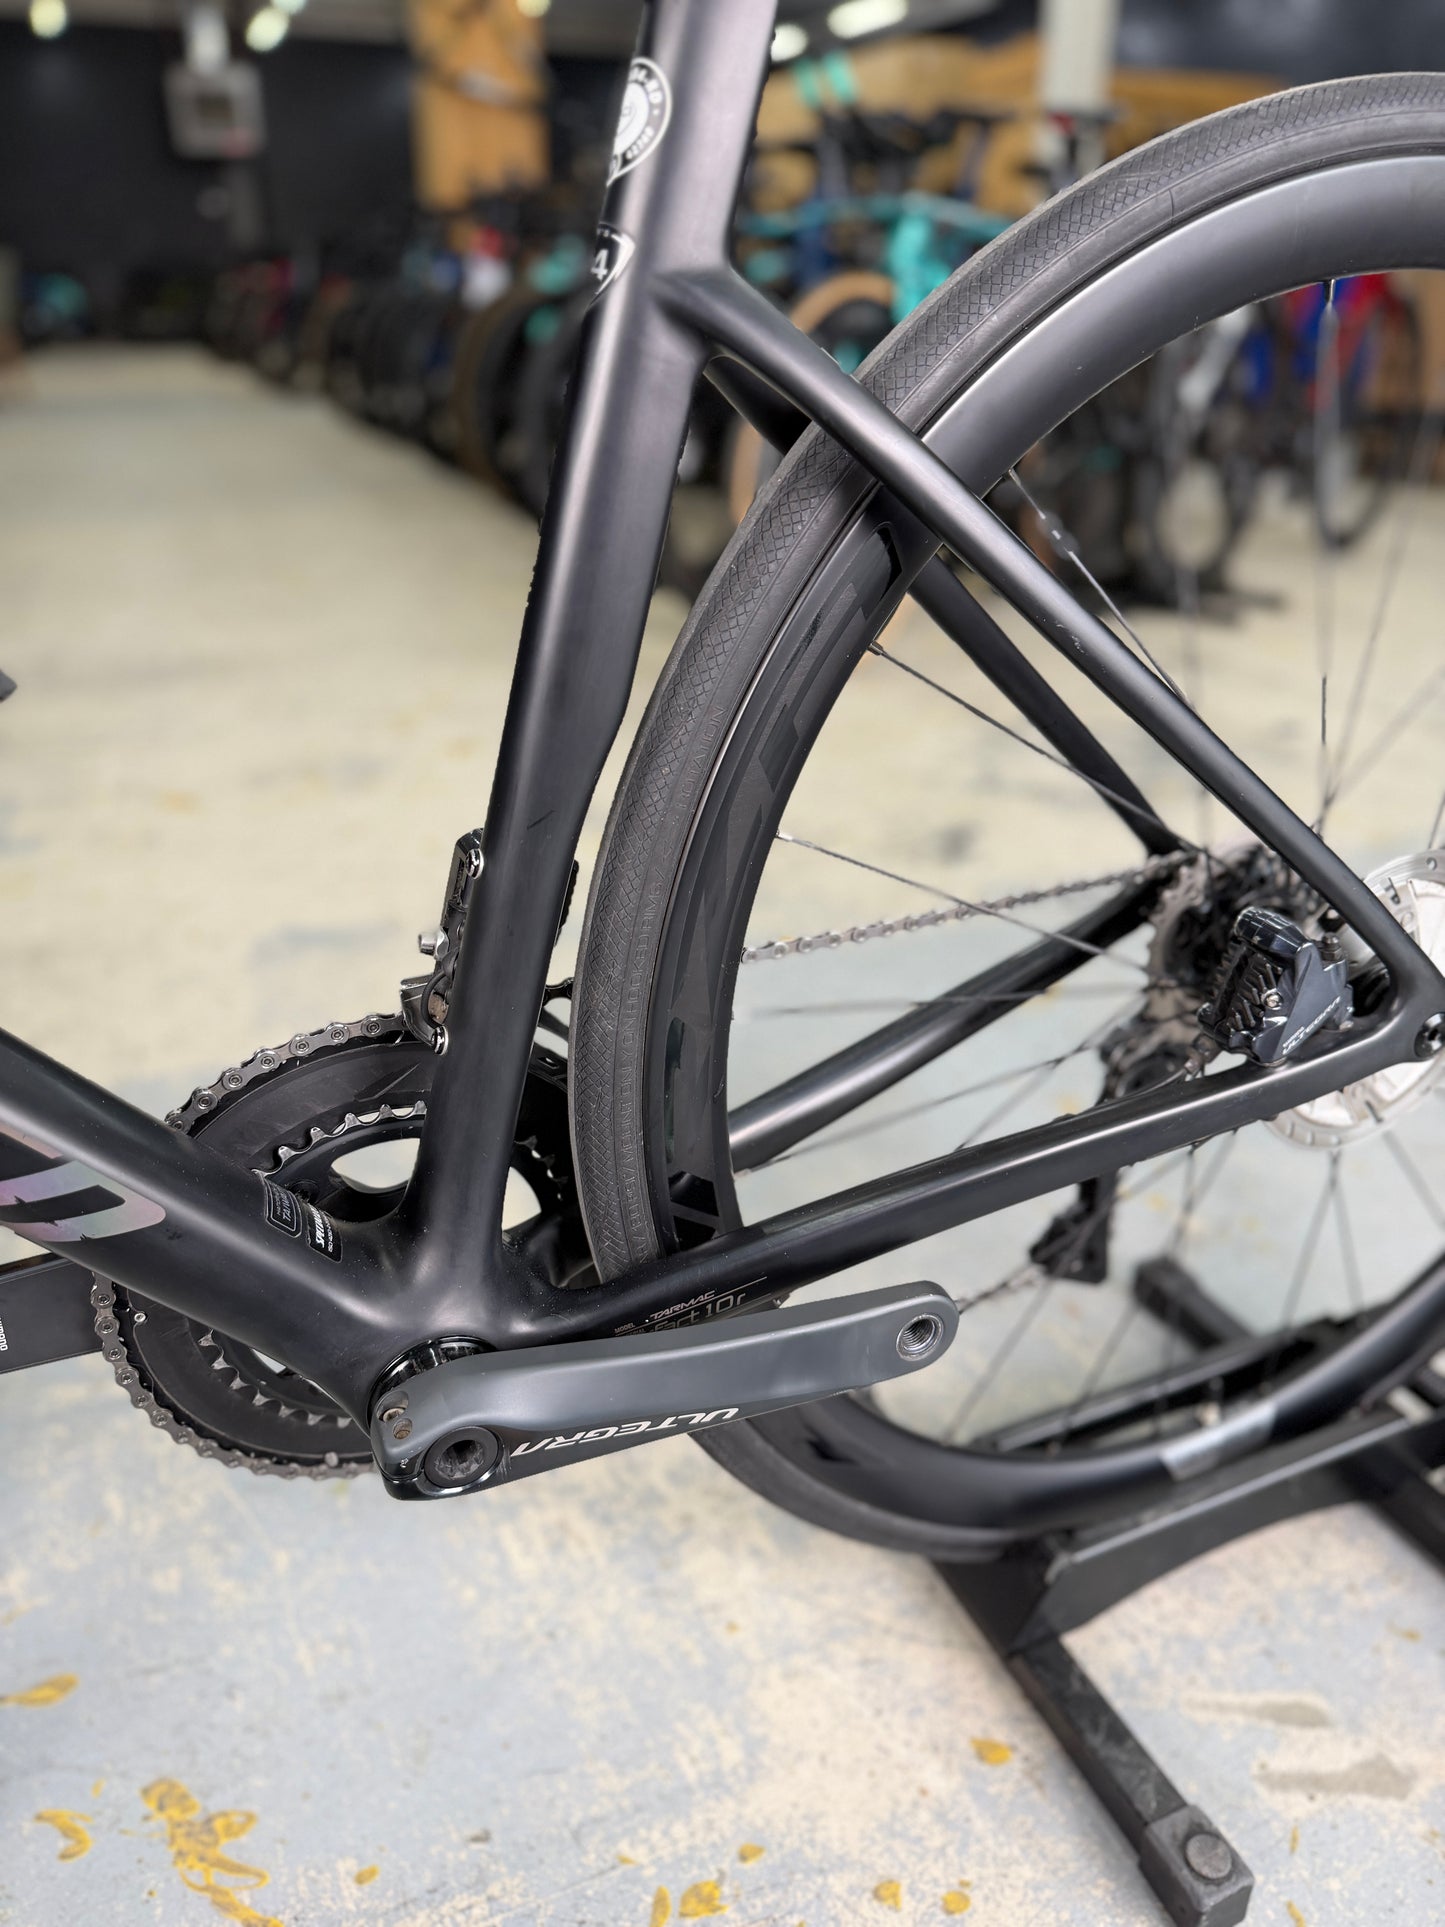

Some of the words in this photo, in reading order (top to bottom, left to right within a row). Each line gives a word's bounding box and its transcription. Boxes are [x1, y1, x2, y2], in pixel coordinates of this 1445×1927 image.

[1282, 996, 1341, 1055] ULTEGRA
[650, 1289, 716, 1320] TARMAC
[510, 1407, 740, 1457] ULTEGRA
